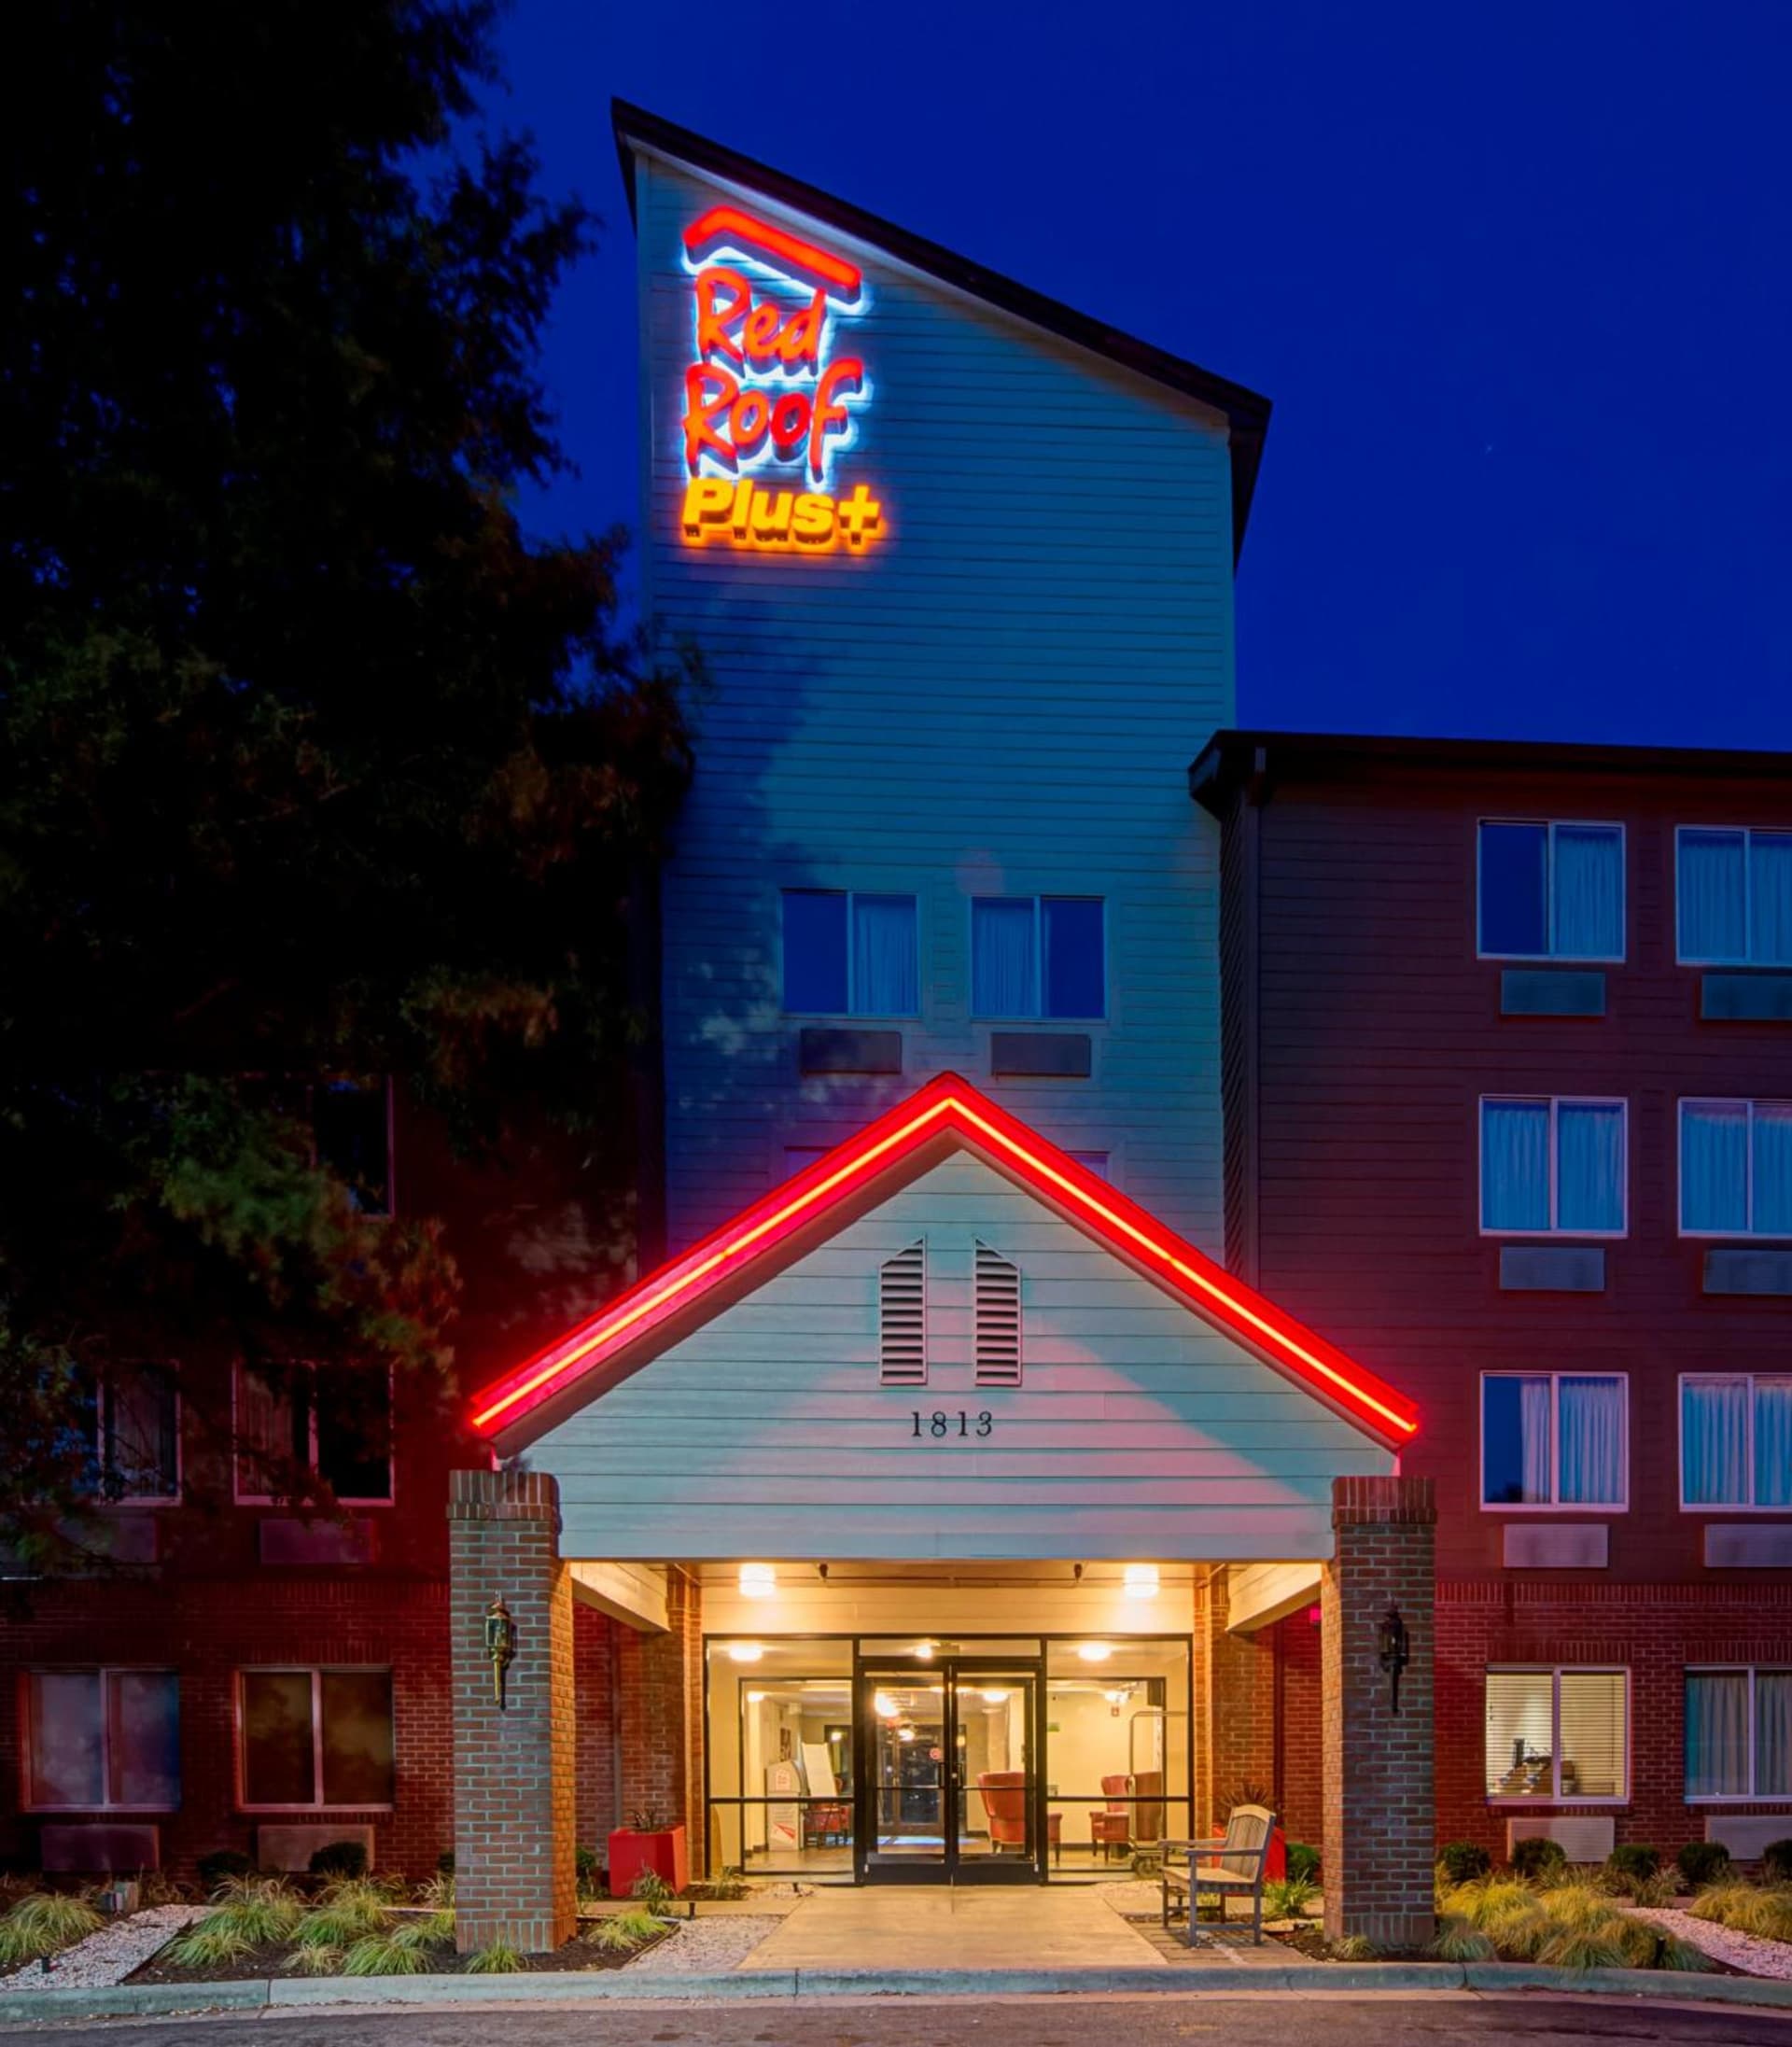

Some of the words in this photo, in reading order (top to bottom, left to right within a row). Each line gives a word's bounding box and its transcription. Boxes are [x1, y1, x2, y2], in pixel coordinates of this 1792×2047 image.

[695, 267, 827, 373] Red
[683, 358, 863, 478] Roof
[683, 477, 881, 540] Plus+
[911, 1410, 992, 1437] 1813
